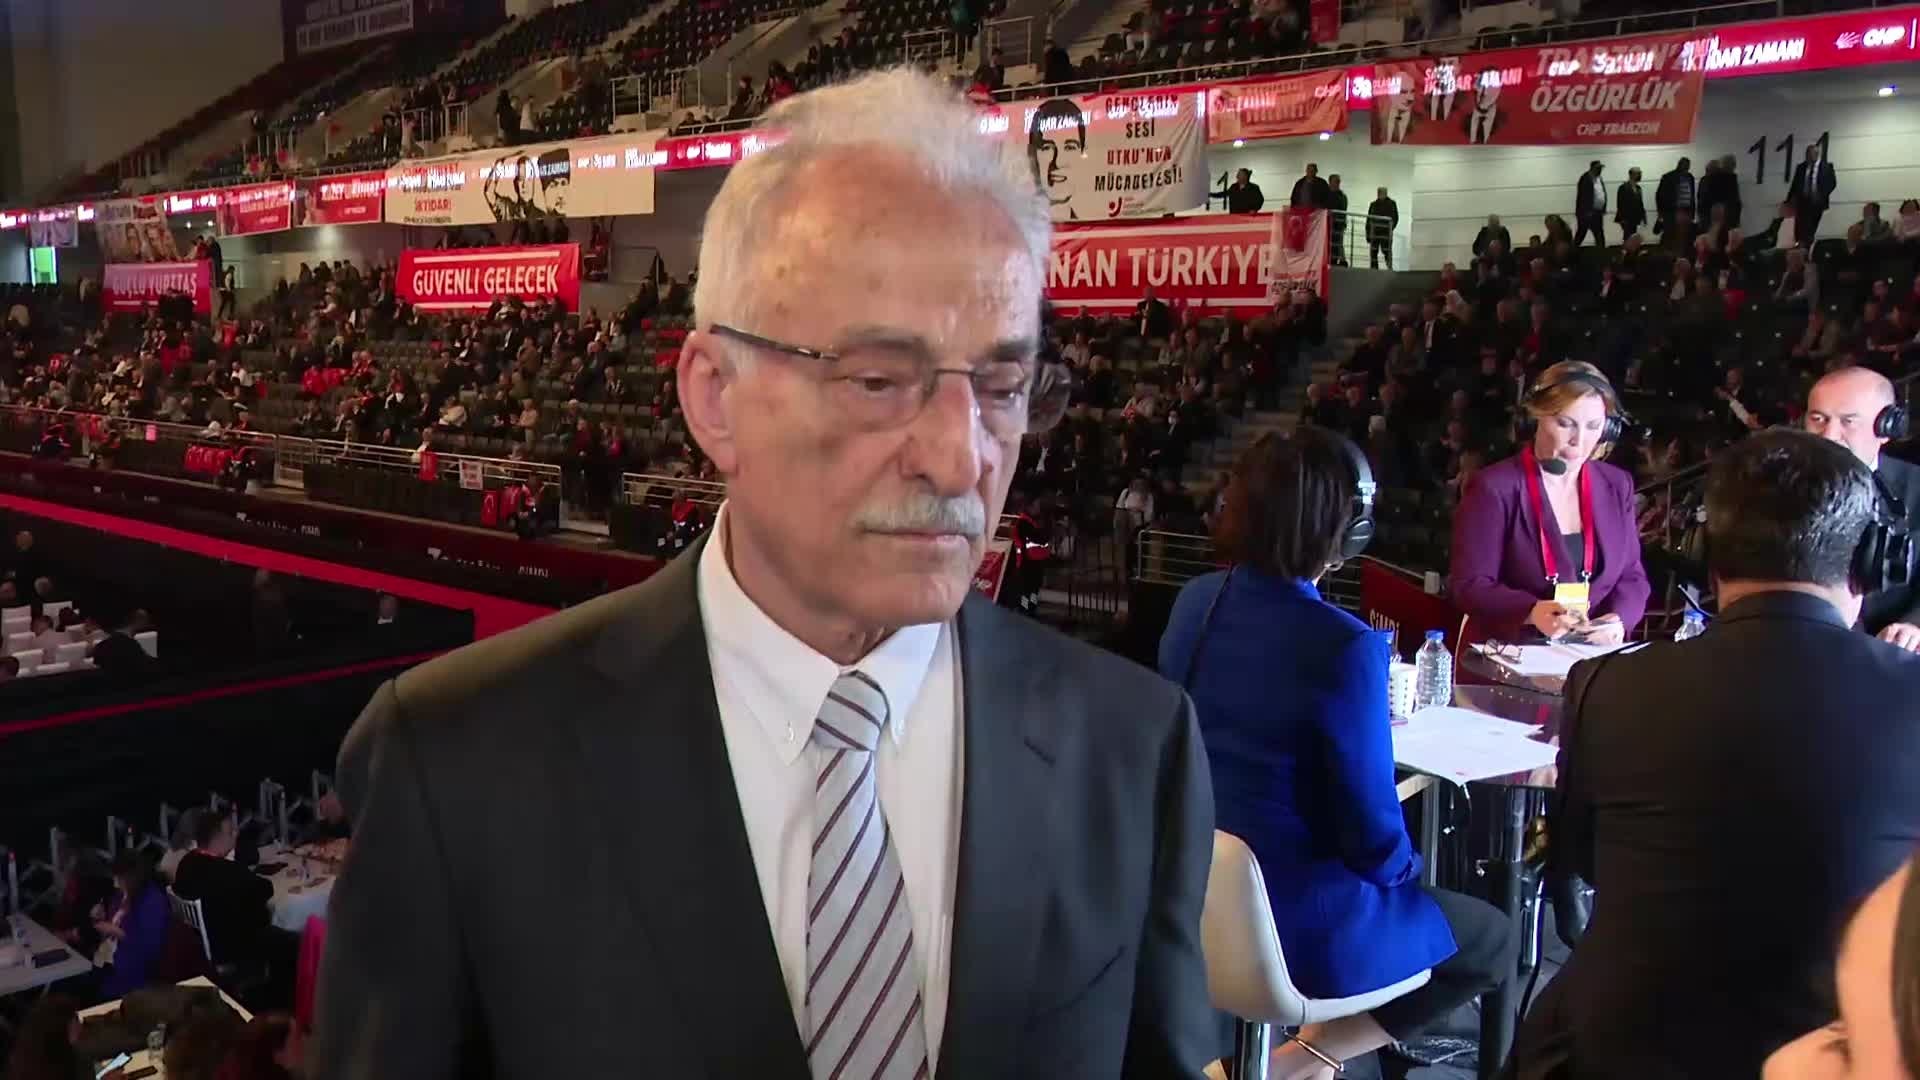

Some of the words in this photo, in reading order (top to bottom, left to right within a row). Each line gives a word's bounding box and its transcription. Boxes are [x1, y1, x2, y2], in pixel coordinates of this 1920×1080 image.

[1863, 26, 1905, 47] CHP
[1741, 38, 1805, 66] ZAMANI
[1530, 78, 1682, 112] ÖZGÜRLÜK
[1126, 116, 1155, 138] SESİ
[1577, 122, 1601, 136] CHP
[483, 263, 559, 294] GELECEK
